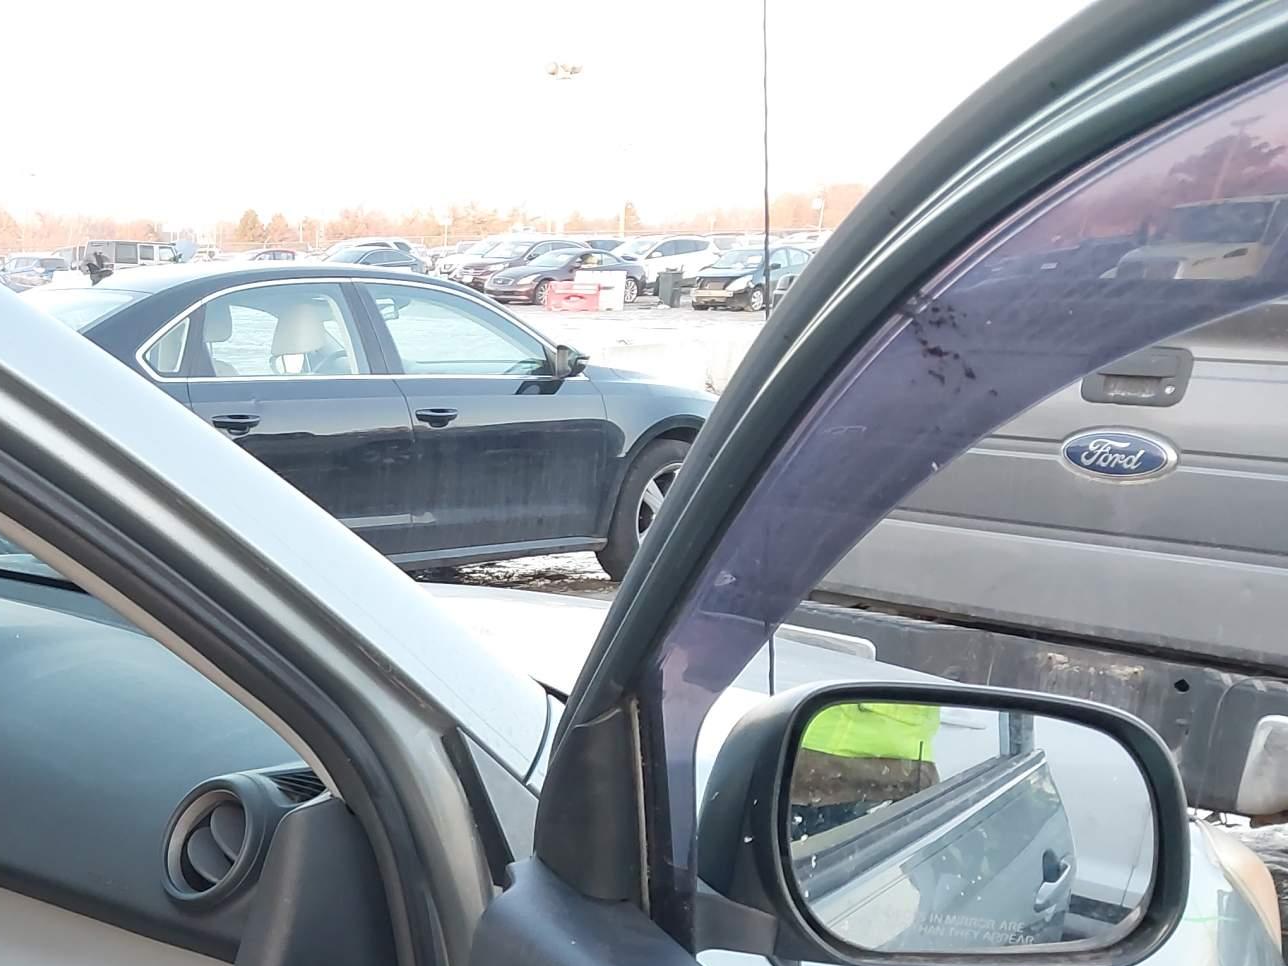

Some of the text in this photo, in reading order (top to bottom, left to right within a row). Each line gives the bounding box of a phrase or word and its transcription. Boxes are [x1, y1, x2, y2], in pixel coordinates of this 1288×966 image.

[1080, 439, 1145, 470] Ford
[929, 912, 943, 924] IN
[999, 920, 1025, 934] ARE
